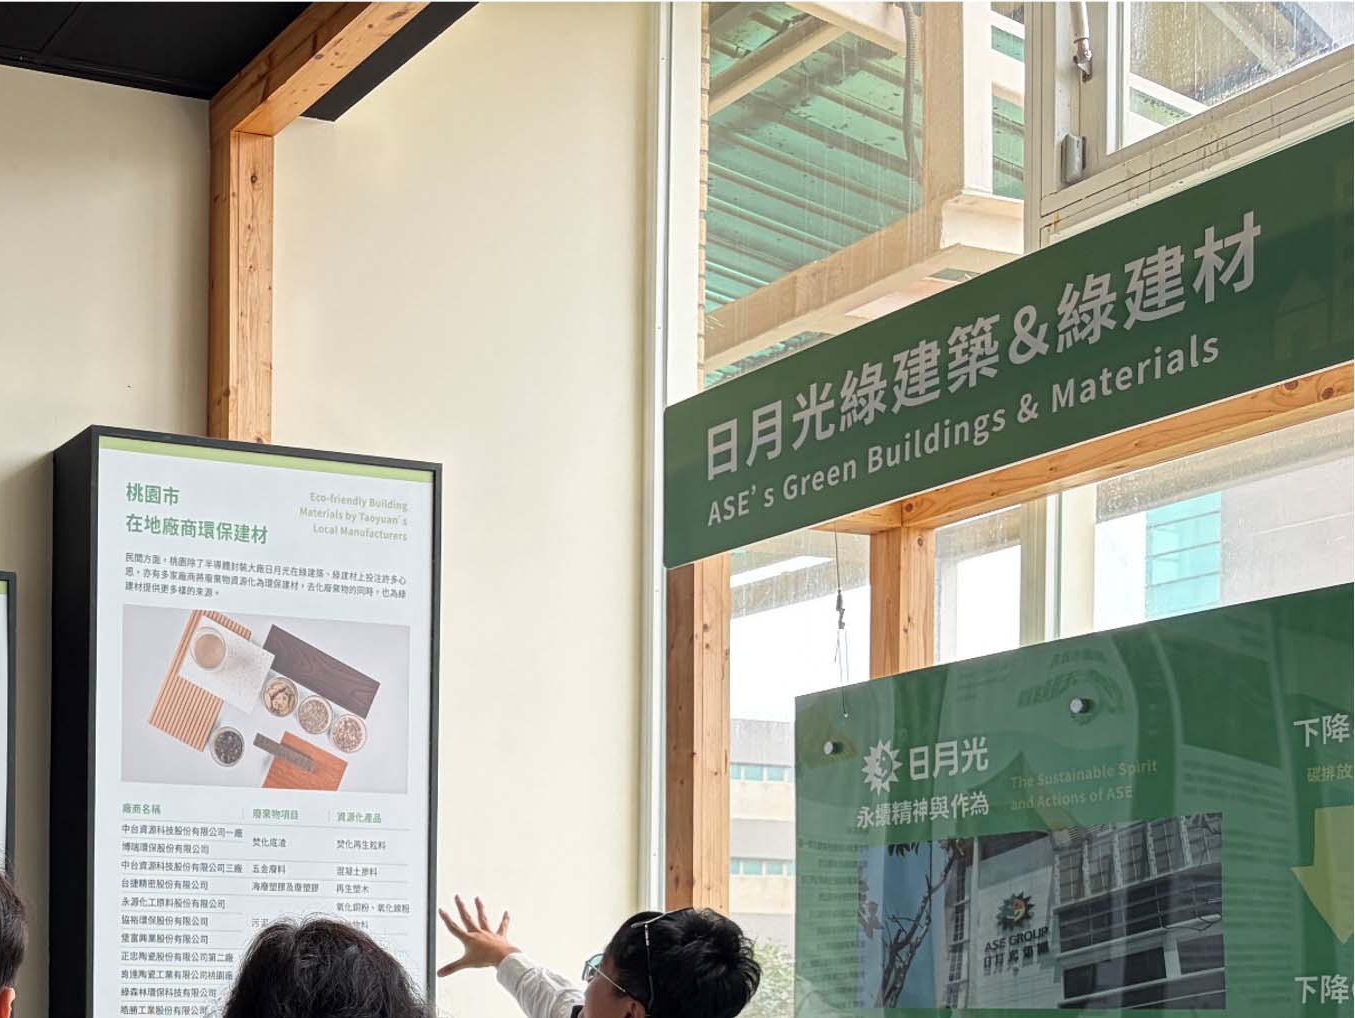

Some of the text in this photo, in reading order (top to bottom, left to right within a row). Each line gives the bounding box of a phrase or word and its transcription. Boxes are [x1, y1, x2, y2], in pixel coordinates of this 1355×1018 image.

[707, 211, 1262, 481] 日月光綠建築&綠建材
[783, 455, 857, 500] Green
[867, 409, 1006, 473] Buildings
[1017, 393, 1040, 423] &
[1051, 333, 1220, 415] Materials
[126, 482, 180, 506] 桃園市
[310, 492, 408, 512] Eco-friendly Building
[126, 514, 268, 545] 在地廠商環保建材
[300, 507, 343, 521] Materials
[345, 510, 357, 522] by
[313, 524, 408, 541] Local Manufacturers
[1293, 713, 1349, 748] 下降
[908, 737, 989, 782] 日月光
[1118, 759, 1158, 779] Spirit
[1106, 785, 1133, 800] ASE
[857, 791, 990, 829] 永續精神與作為
[1294, 973, 1354, 1005] 下降
